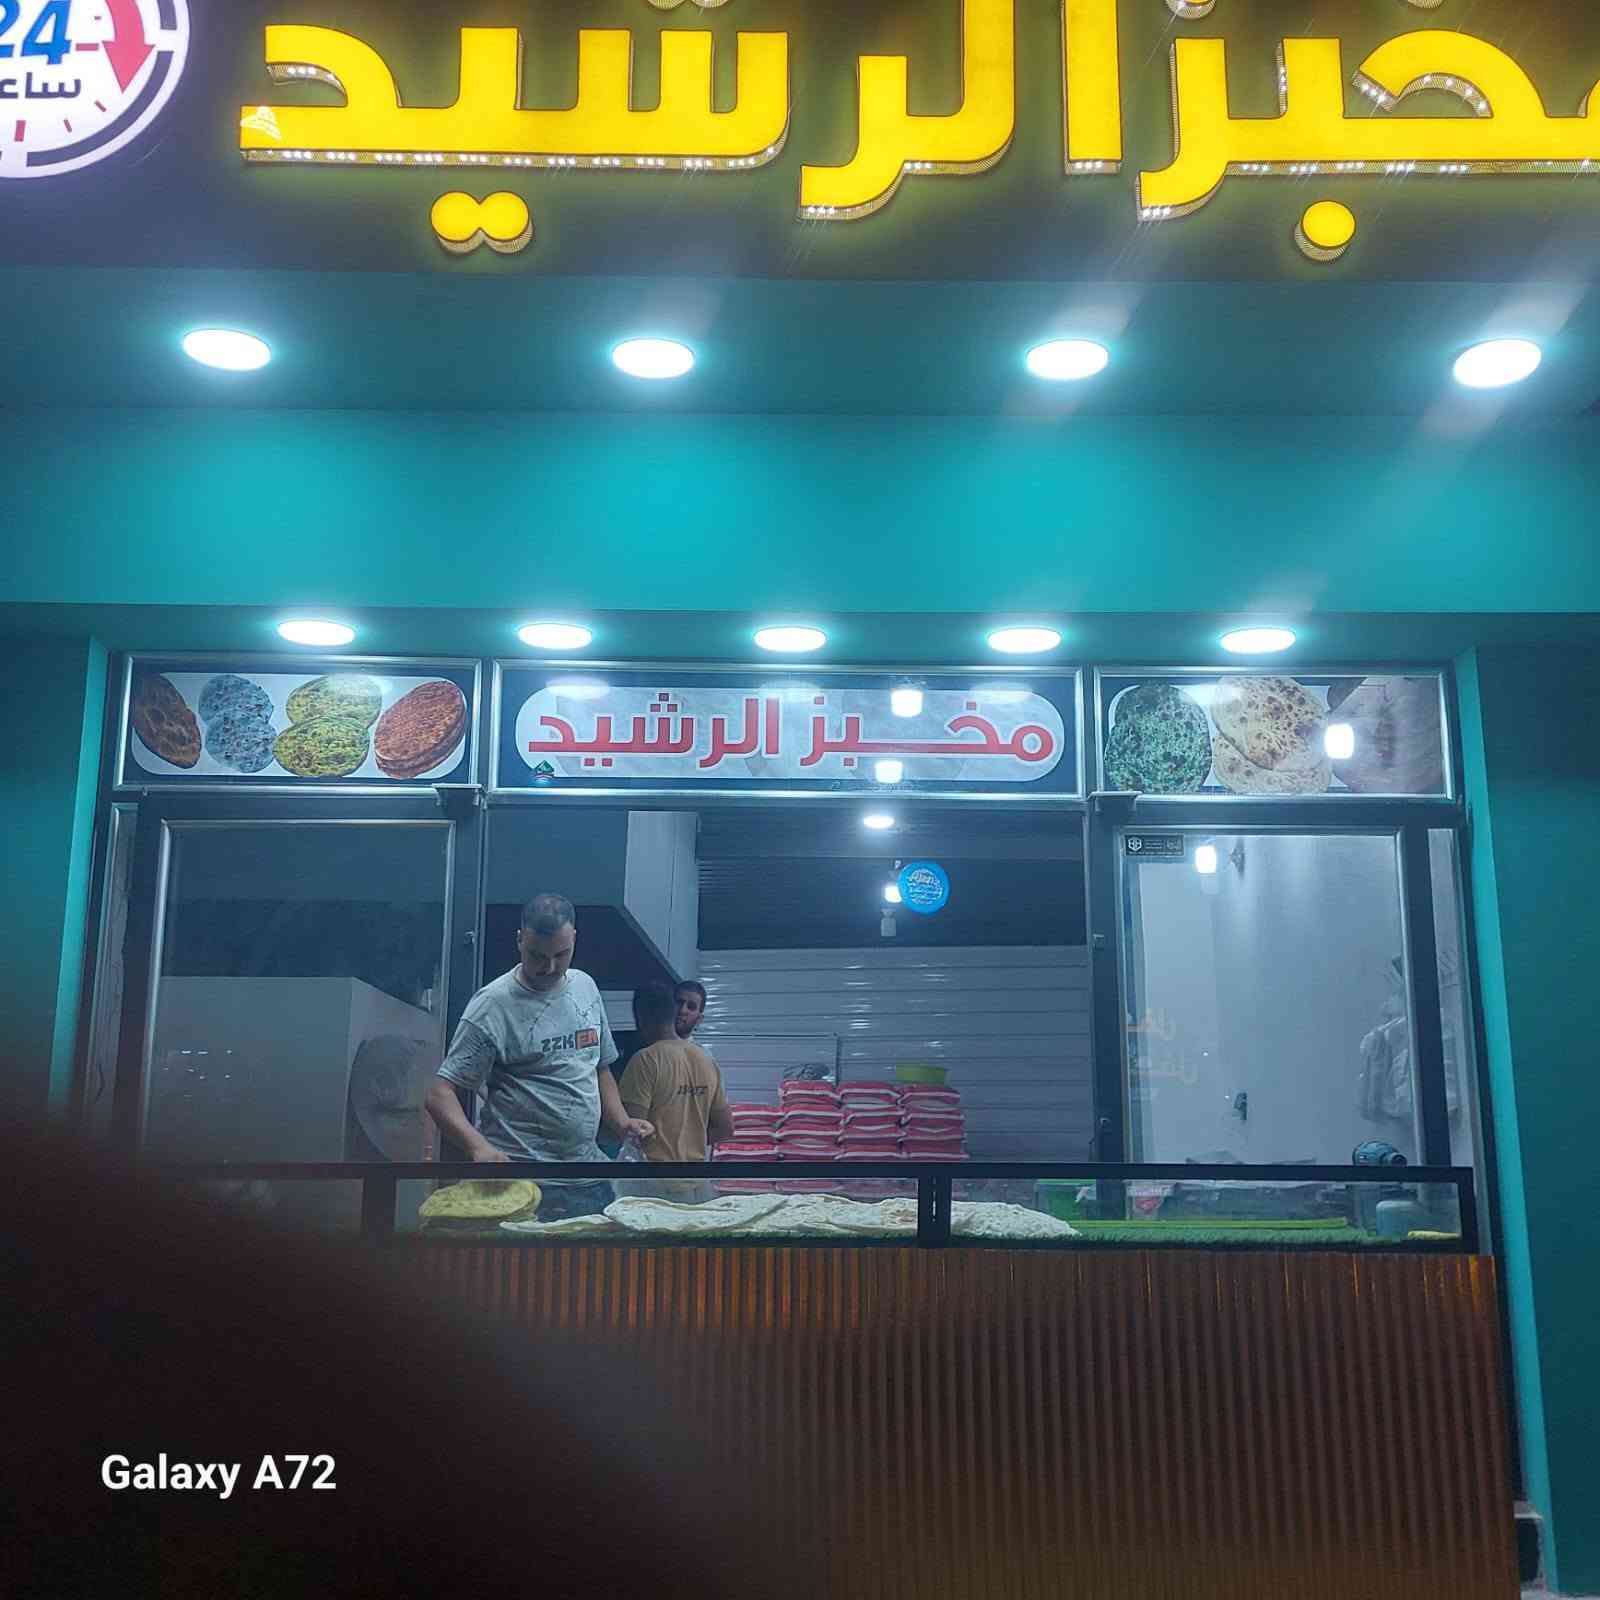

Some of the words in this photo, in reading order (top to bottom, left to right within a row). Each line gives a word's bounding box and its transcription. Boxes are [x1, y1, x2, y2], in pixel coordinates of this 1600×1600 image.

[0, 71, 81, 100] ساع
[240, 0, 1121, 246] الرشيد
[1138, 0, 1600, 249] خبز
[528, 692, 780, 768] الرشيد
[800, 695, 1055, 768] مخبز
